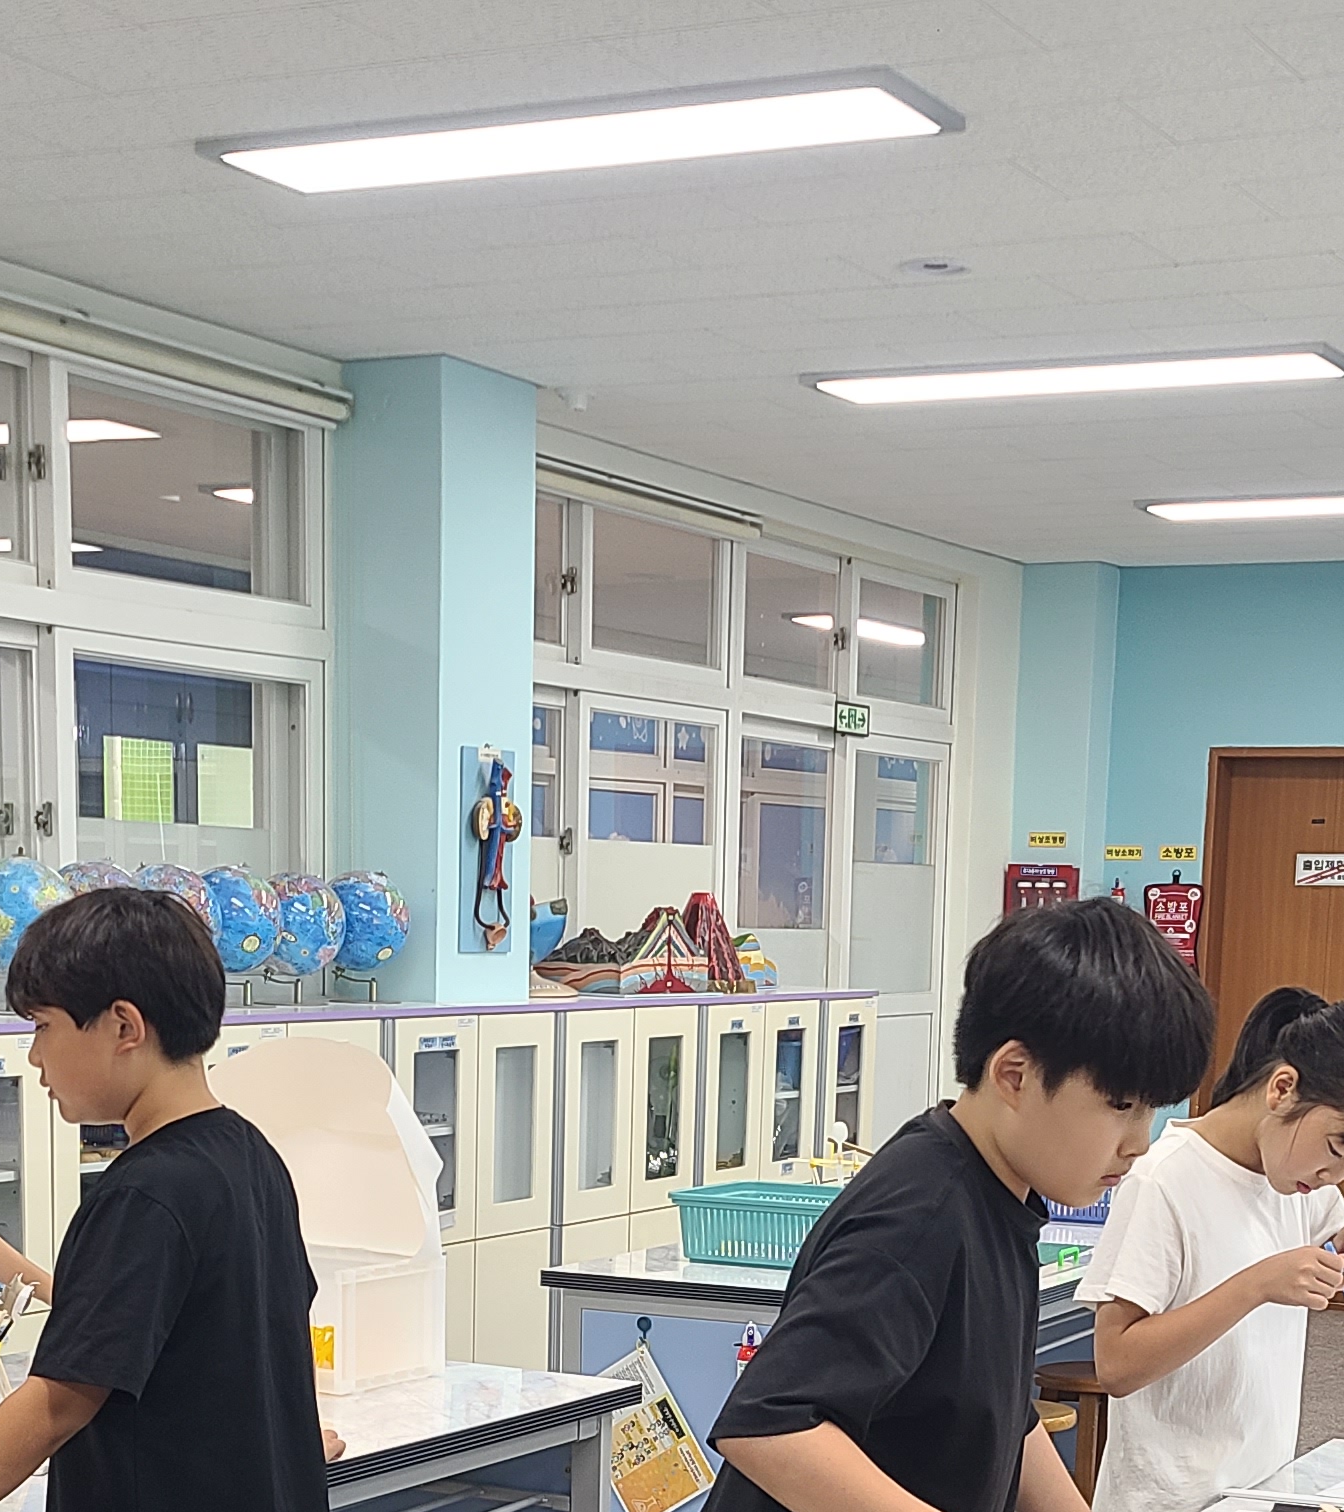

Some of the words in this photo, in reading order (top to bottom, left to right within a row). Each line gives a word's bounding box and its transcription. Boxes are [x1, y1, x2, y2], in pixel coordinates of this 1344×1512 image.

[1030, 835, 1065, 845] 비상조명등
[1106, 848, 1142, 858] 비상소화기
[1162, 847, 1194, 859] 소방포
[1155, 901, 1189, 913] 소방포
